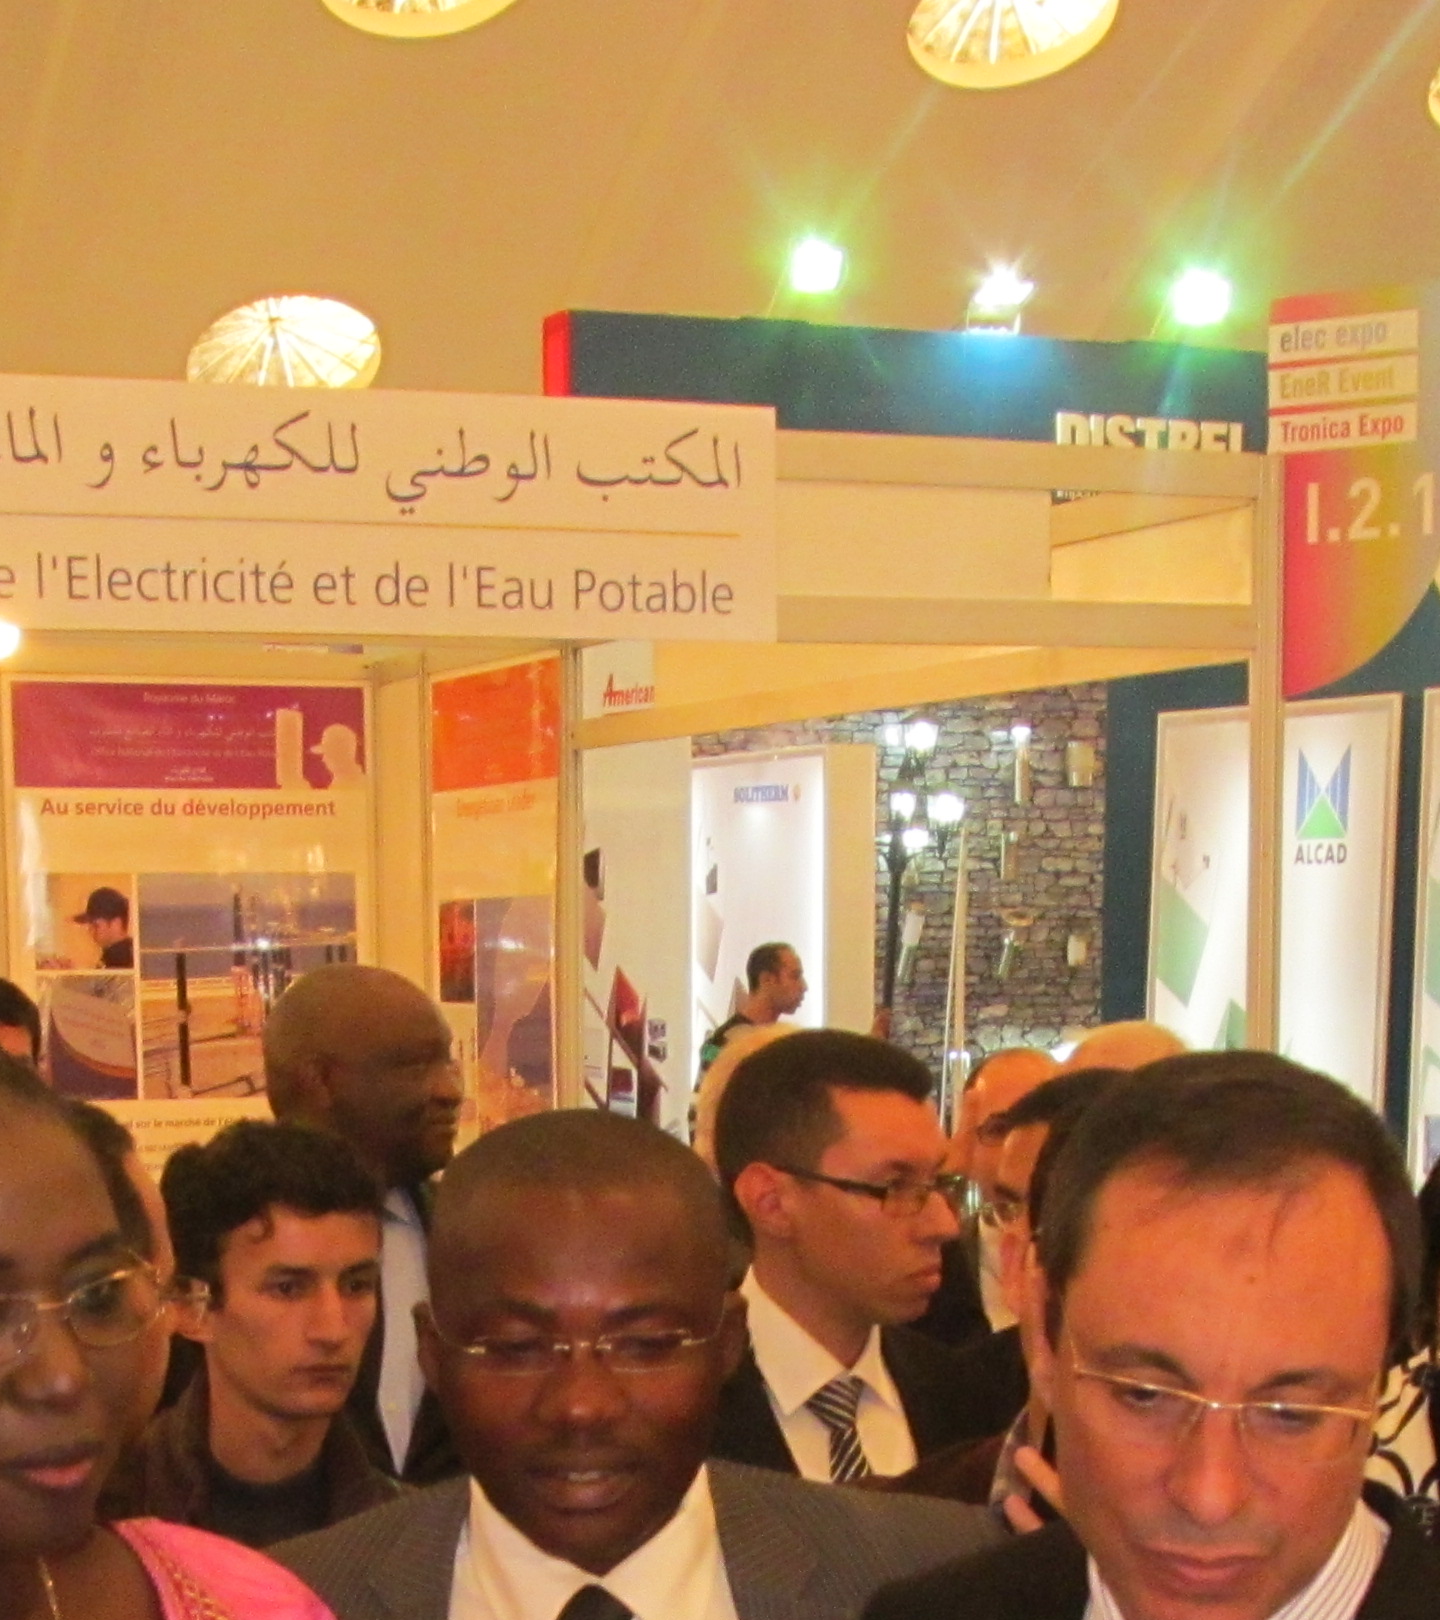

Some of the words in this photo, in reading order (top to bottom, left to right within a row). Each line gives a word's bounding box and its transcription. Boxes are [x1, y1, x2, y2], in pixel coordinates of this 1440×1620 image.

[1280, 325, 1326, 352] elec
[1335, 321, 1387, 350] expo
[1280, 370, 1330, 399] EneR
[1339, 366, 1394, 394] Event
[1281, 416, 1350, 443] Tronica
[1359, 413, 1405, 440] Expo
[87, 442, 116, 490] و
[141, 410, 359, 492] للكهرباء
[576, 427, 742, 502] المكتب
[385, 427, 551, 516] الوطني
[36, 552, 294, 604] l'Electricité
[312, 564, 357, 607] et
[374, 561, 430, 608] de
[448, 562, 554, 611] l'Eau
[574, 568, 734, 616] Potable
[41, 799, 71, 817] Au
[75, 798, 143, 817] service
[150, 798, 176, 817] du
[182, 798, 336, 820] développement
[1294, 843, 1348, 866] ALCAD
